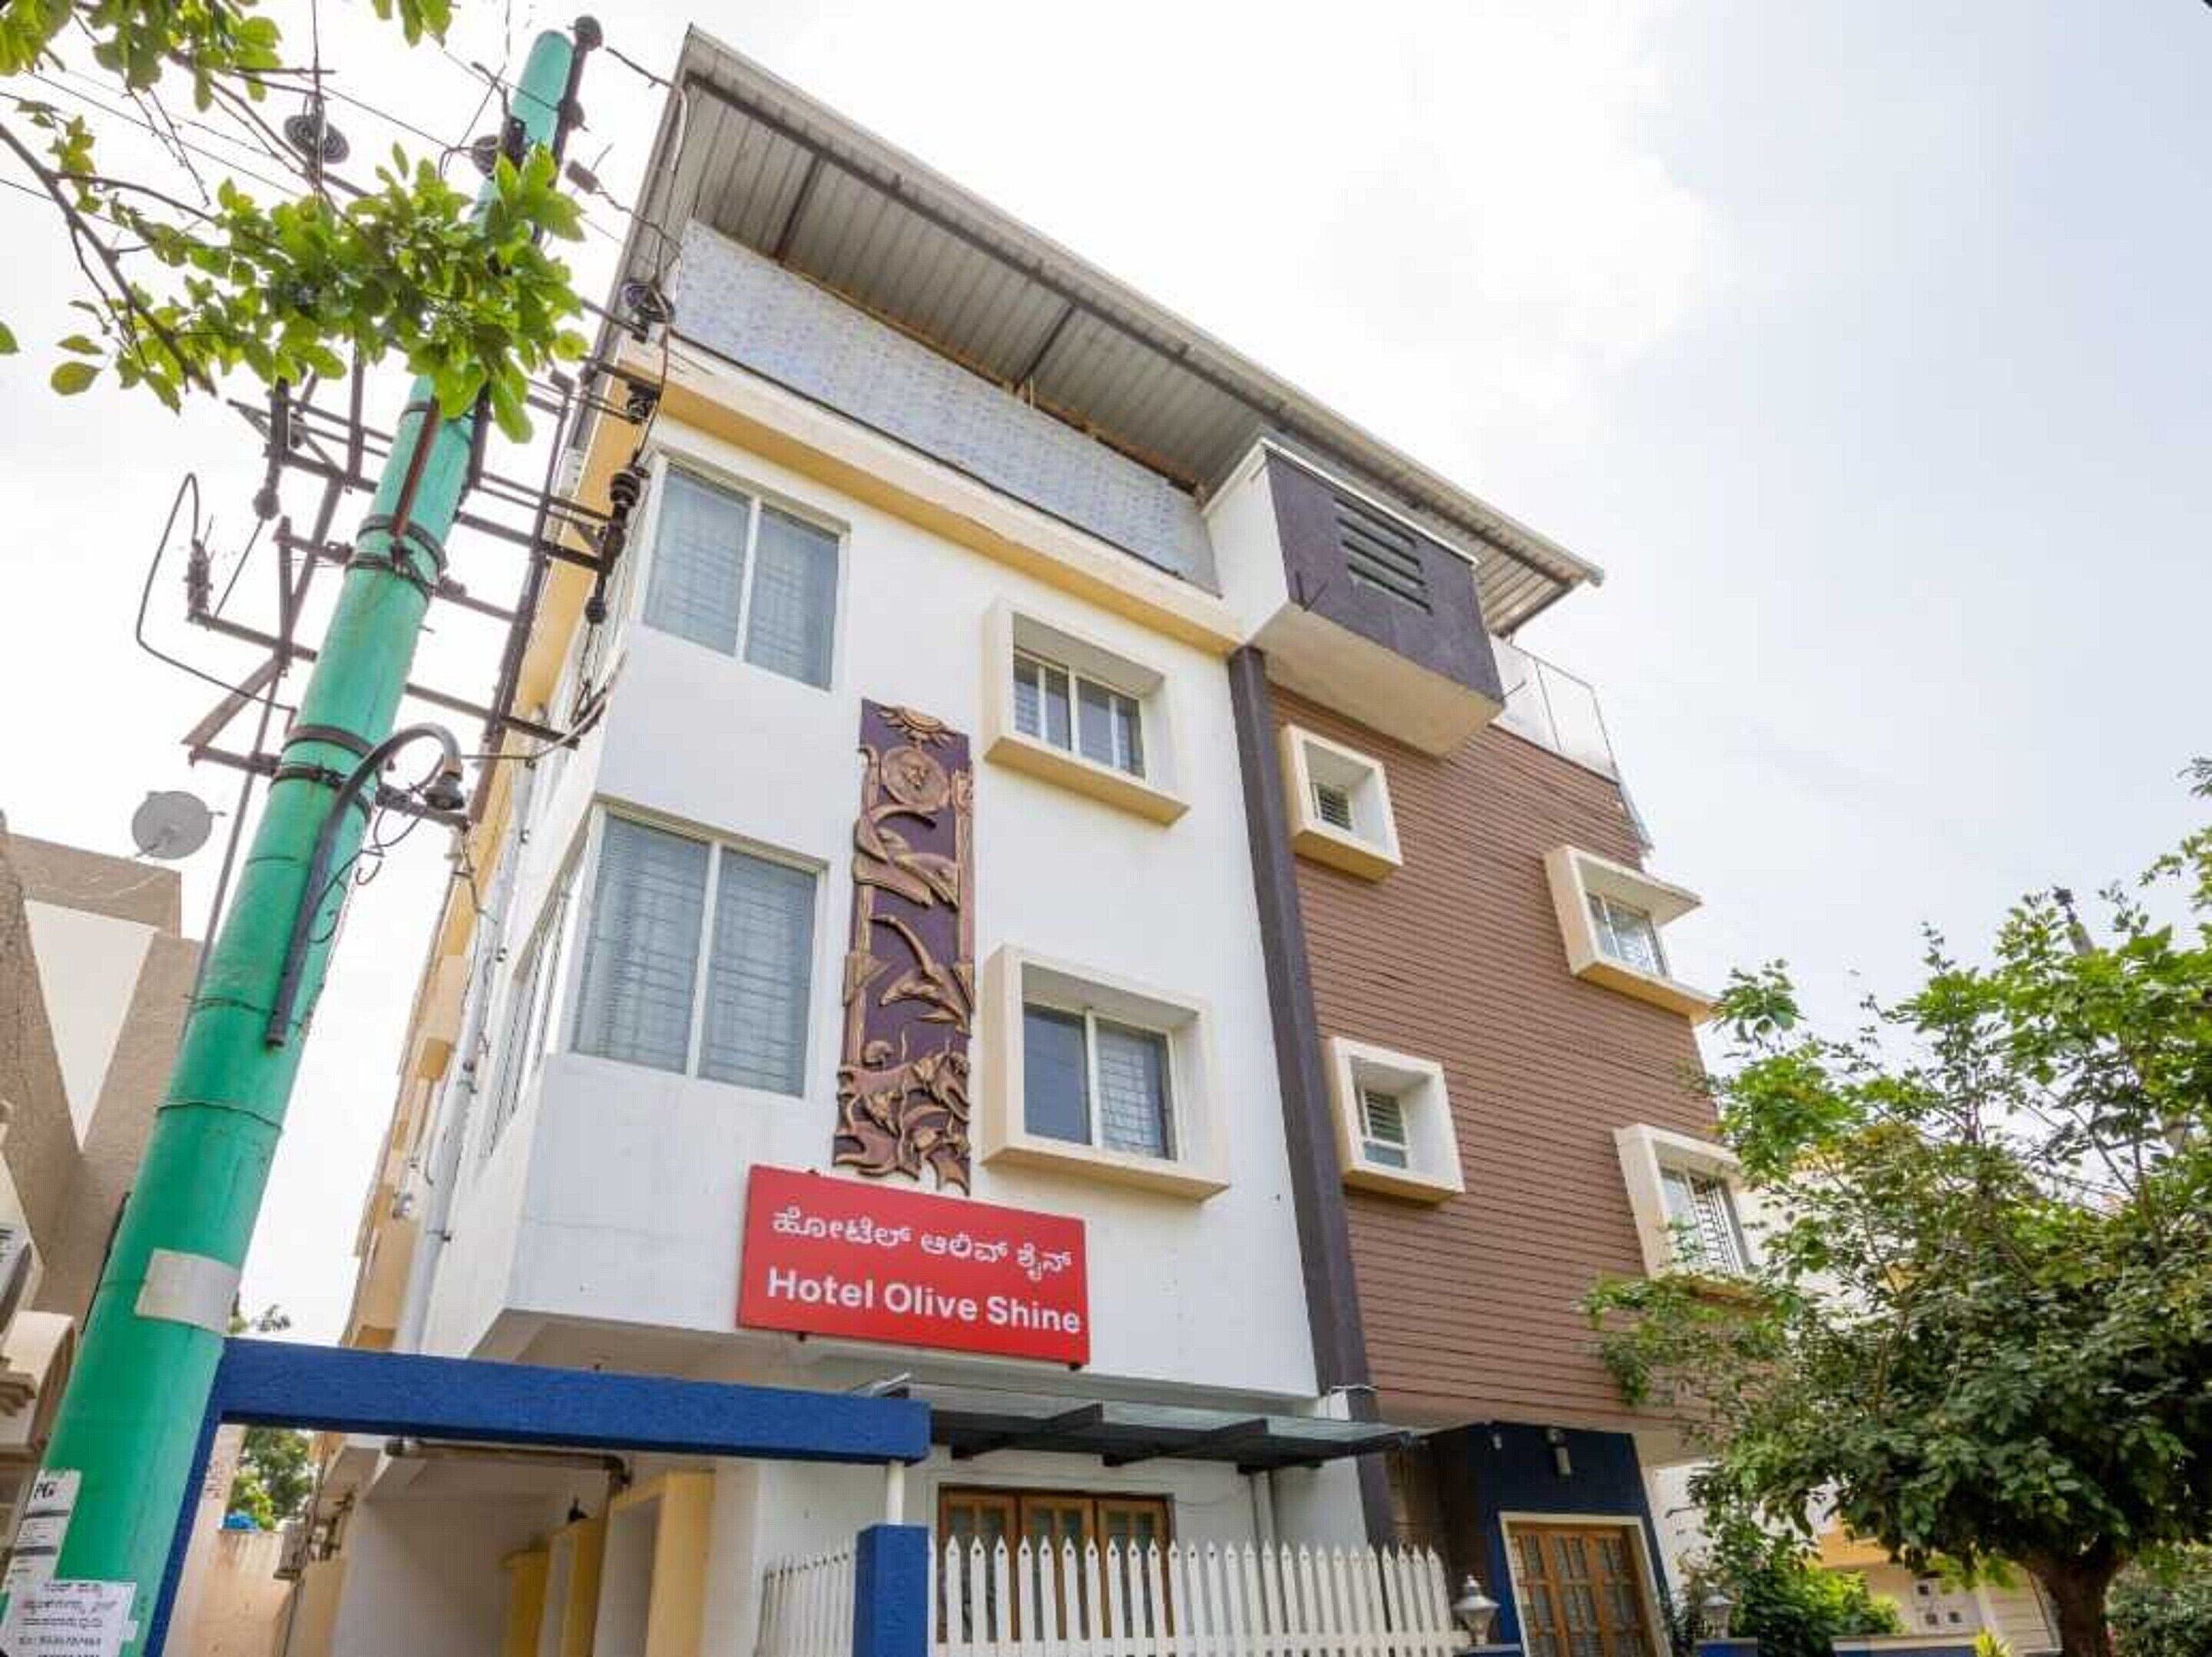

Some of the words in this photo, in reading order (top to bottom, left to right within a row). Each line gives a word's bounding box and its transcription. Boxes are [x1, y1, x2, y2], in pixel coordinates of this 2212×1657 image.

[767, 1266, 873, 1308] Hotel
[884, 1282, 978, 1321] Olive
[986, 1295, 1081, 1334] Shine
